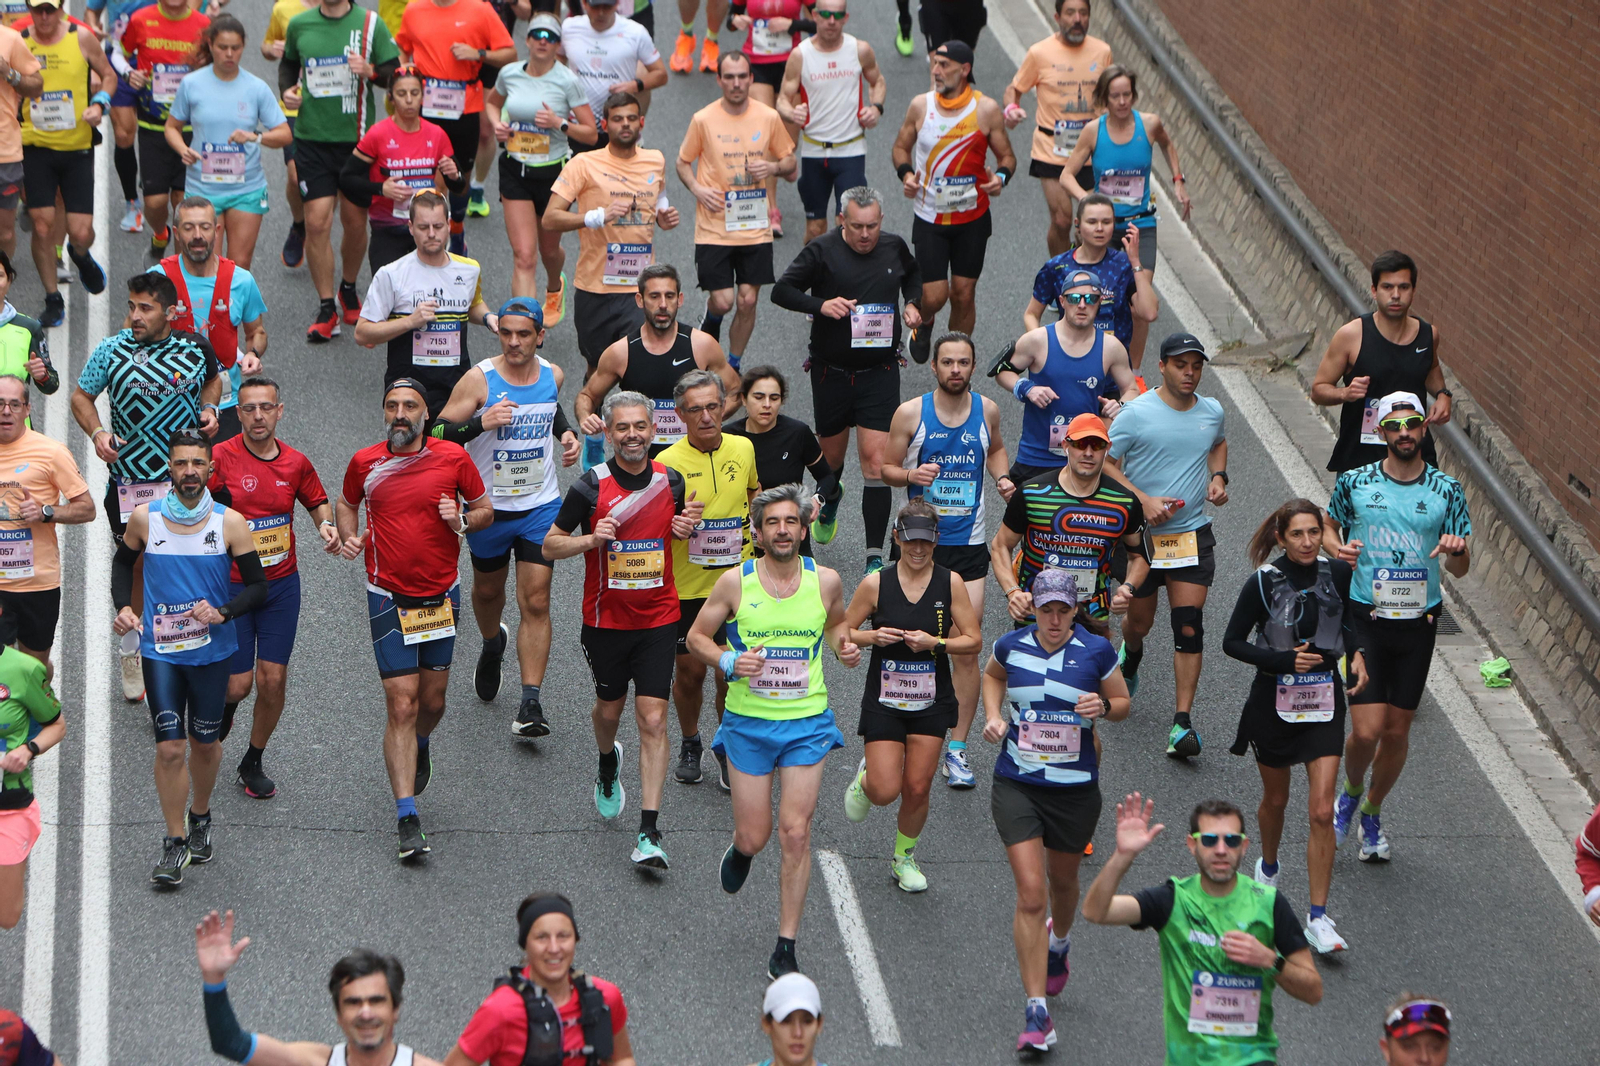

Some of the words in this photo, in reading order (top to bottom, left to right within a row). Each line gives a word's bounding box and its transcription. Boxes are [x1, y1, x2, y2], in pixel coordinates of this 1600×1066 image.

[810, 68, 855, 82] DANMARK
[215, 144, 240, 152] ZURICH
[408, 180, 432, 188] ZURICH
[949, 176, 973, 186] ZURICH
[738, 190, 763, 199] ZURICH
[430, 323, 457, 331] ZURICH
[867, 319, 882, 327] 7088
[430, 337, 447, 345] 7153
[658, 415, 676, 423] 7333
[511, 450, 539, 460] ZURICH
[929, 454, 975, 464] GARMIN
[510, 466, 529, 475] 9229
[942, 471, 972, 479] ZURICH
[136, 489, 154, 498] 8059
[938, 486, 961, 495] 12074
[932, 497, 949, 505] DAVID
[258, 516, 286, 528] ZURICH
[708, 519, 737, 528] ZURICH
[1070, 513, 1107, 526] XXXVIII
[0, 531, 26, 540] URICH
[259, 534, 277, 545] 3978
[707, 535, 726, 544] 6465
[1034, 530, 1052, 541] SAN
[1054, 534, 1106, 548] SILVESTRE
[256, 545, 285, 558] AM-KENIA
[702, 547, 731, 555] BERNARD
[1033, 540, 1093, 557] SALMANTINA
[2, 559, 31, 567] MARTINS
[626, 558, 646, 568] 5089
[1061, 558, 1092, 567] ZURICH
[1392, 550, 1405, 567] 57
[611, 570, 632, 580] JESÚS
[632, 569, 662, 580] CAMISÓN
[1392, 571, 1423, 580] ZURICH
[1391, 587, 1411, 596] 8722
[1400, 600, 1420, 608] Casado
[417, 609, 436, 620] 6146
[170, 618, 190, 630] 7392
[404, 618, 452, 634] NOAHSITOFANTIT
[161, 627, 209, 642] MANUELPIÑERO
[770, 649, 803, 658] ZURICH
[769, 666, 789, 676] 7941
[899, 663, 930, 672] ZURICH
[898, 679, 918, 688] 7919
[1297, 674, 1326, 684] ZURICH
[757, 680, 774, 688] CRIS
[774, 680, 781, 688] &
[781, 680, 802, 688] MANU
[885, 691, 904, 699] ROCIO
[904, 691, 932, 700] MORAGA
[1296, 691, 1317, 700] 7817
[1292, 703, 1320, 711] REUNION
[1040, 714, 1074, 723] ZURICH
[1039, 729, 1060, 740] 7804
[1031, 743, 1068, 752] RAQUELITA
[1216, 976, 1256, 988] ZURICH
